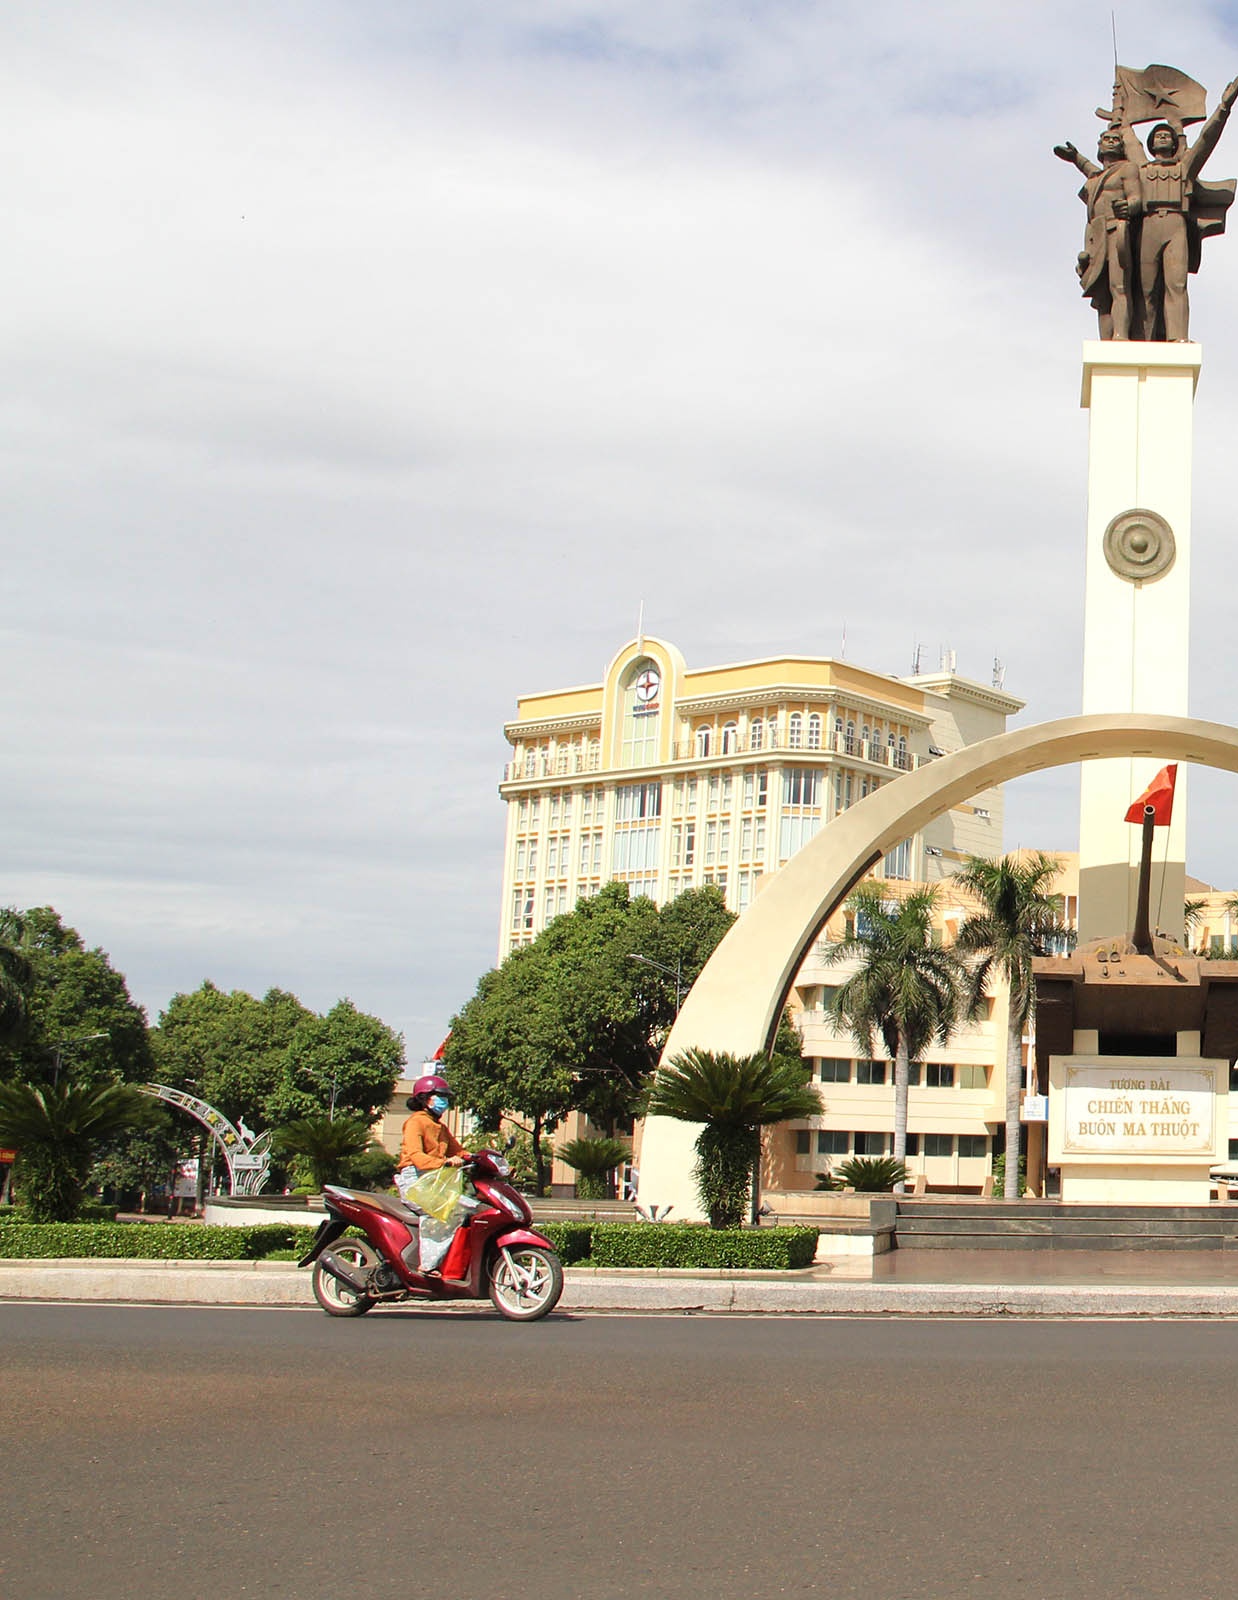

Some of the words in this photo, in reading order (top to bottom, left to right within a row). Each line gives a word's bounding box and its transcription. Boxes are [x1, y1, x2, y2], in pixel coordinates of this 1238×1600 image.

[1110, 1078, 1145, 1091] TƯỢNG
[1150, 1077, 1171, 1090] ĐÀI
[1087, 1095, 1133, 1114] CHIẾN
[1139, 1096, 1191, 1115] THẮNG
[1078, 1118, 1115, 1136] BUÔN
[1122, 1122, 1147, 1136] MA
[1150, 1119, 1200, 1140] THUỘT
